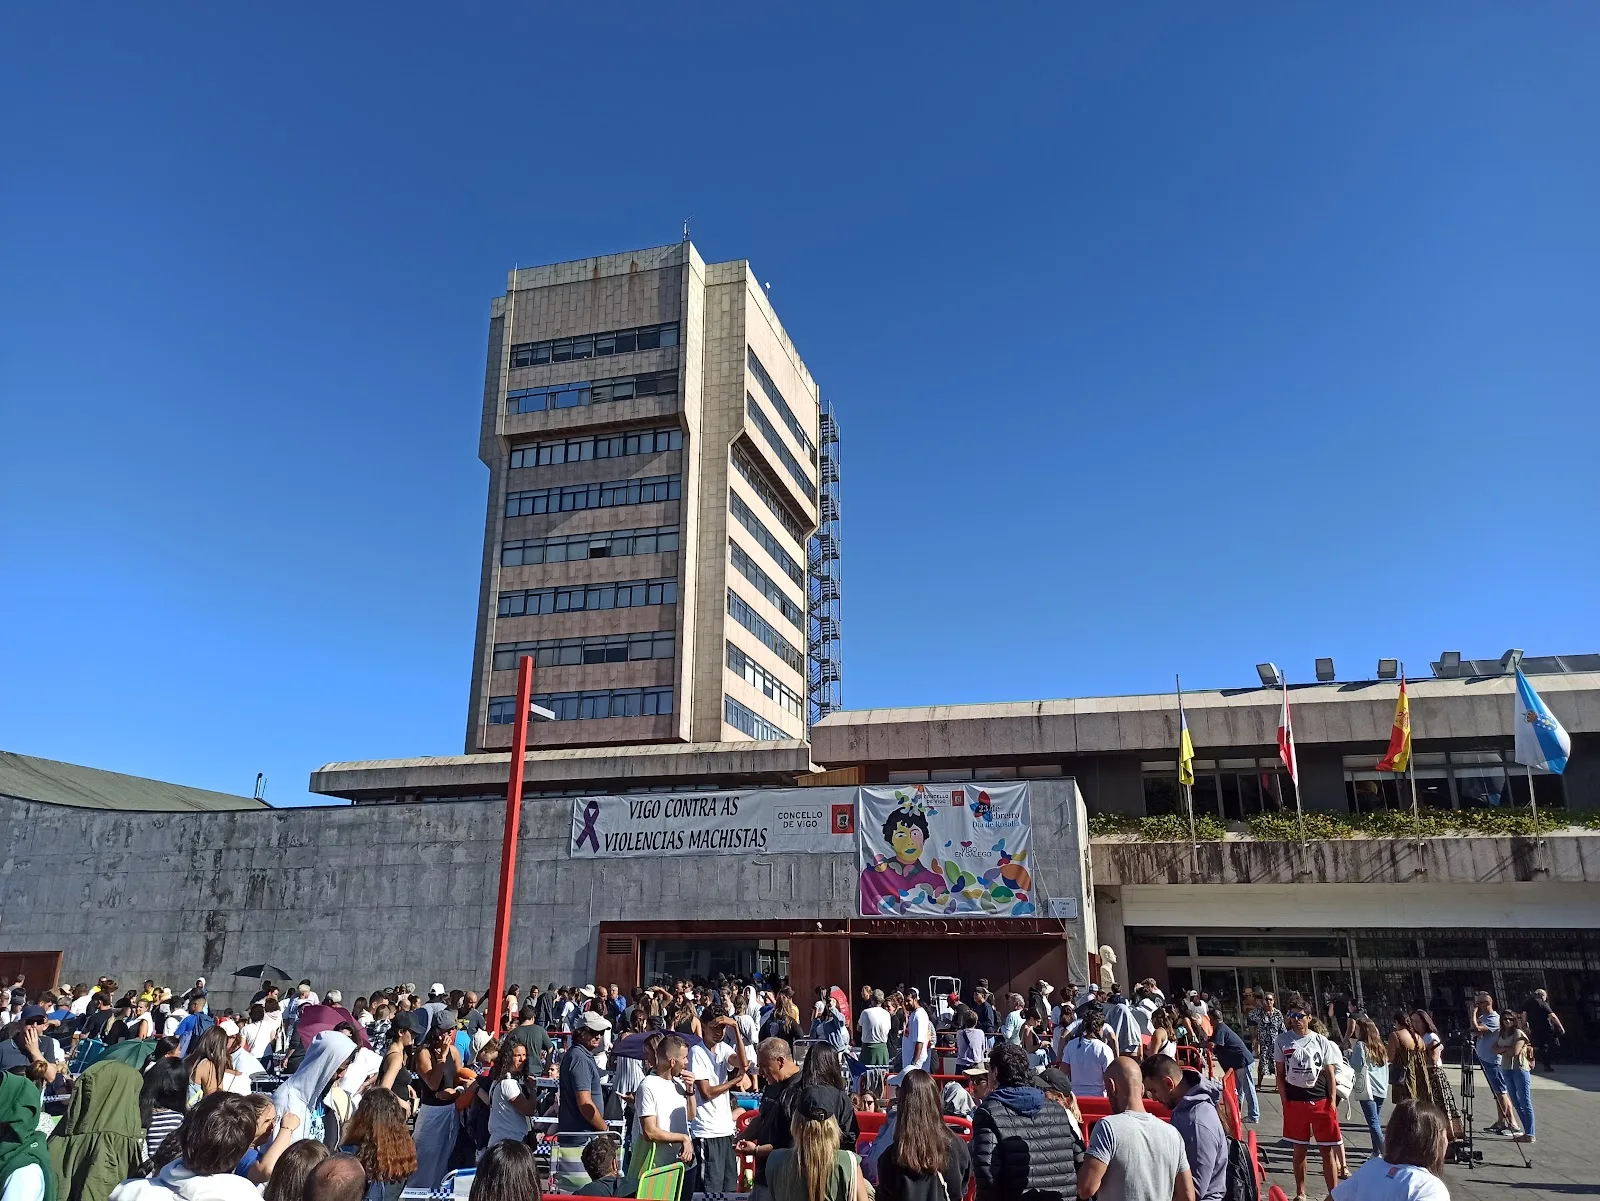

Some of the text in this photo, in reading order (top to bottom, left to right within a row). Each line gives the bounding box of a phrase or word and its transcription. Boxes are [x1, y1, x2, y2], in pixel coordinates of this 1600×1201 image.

[629, 796, 740, 820] VIGO CONTRA AS
[978, 804, 1000, 813] 23 de
[777, 811, 823, 820] CONCELLO
[782, 820, 818, 829] DE VIGO
[985, 820, 994, 828] de
[604, 828, 768, 852] VIOLENCIAS MACHISTAS
